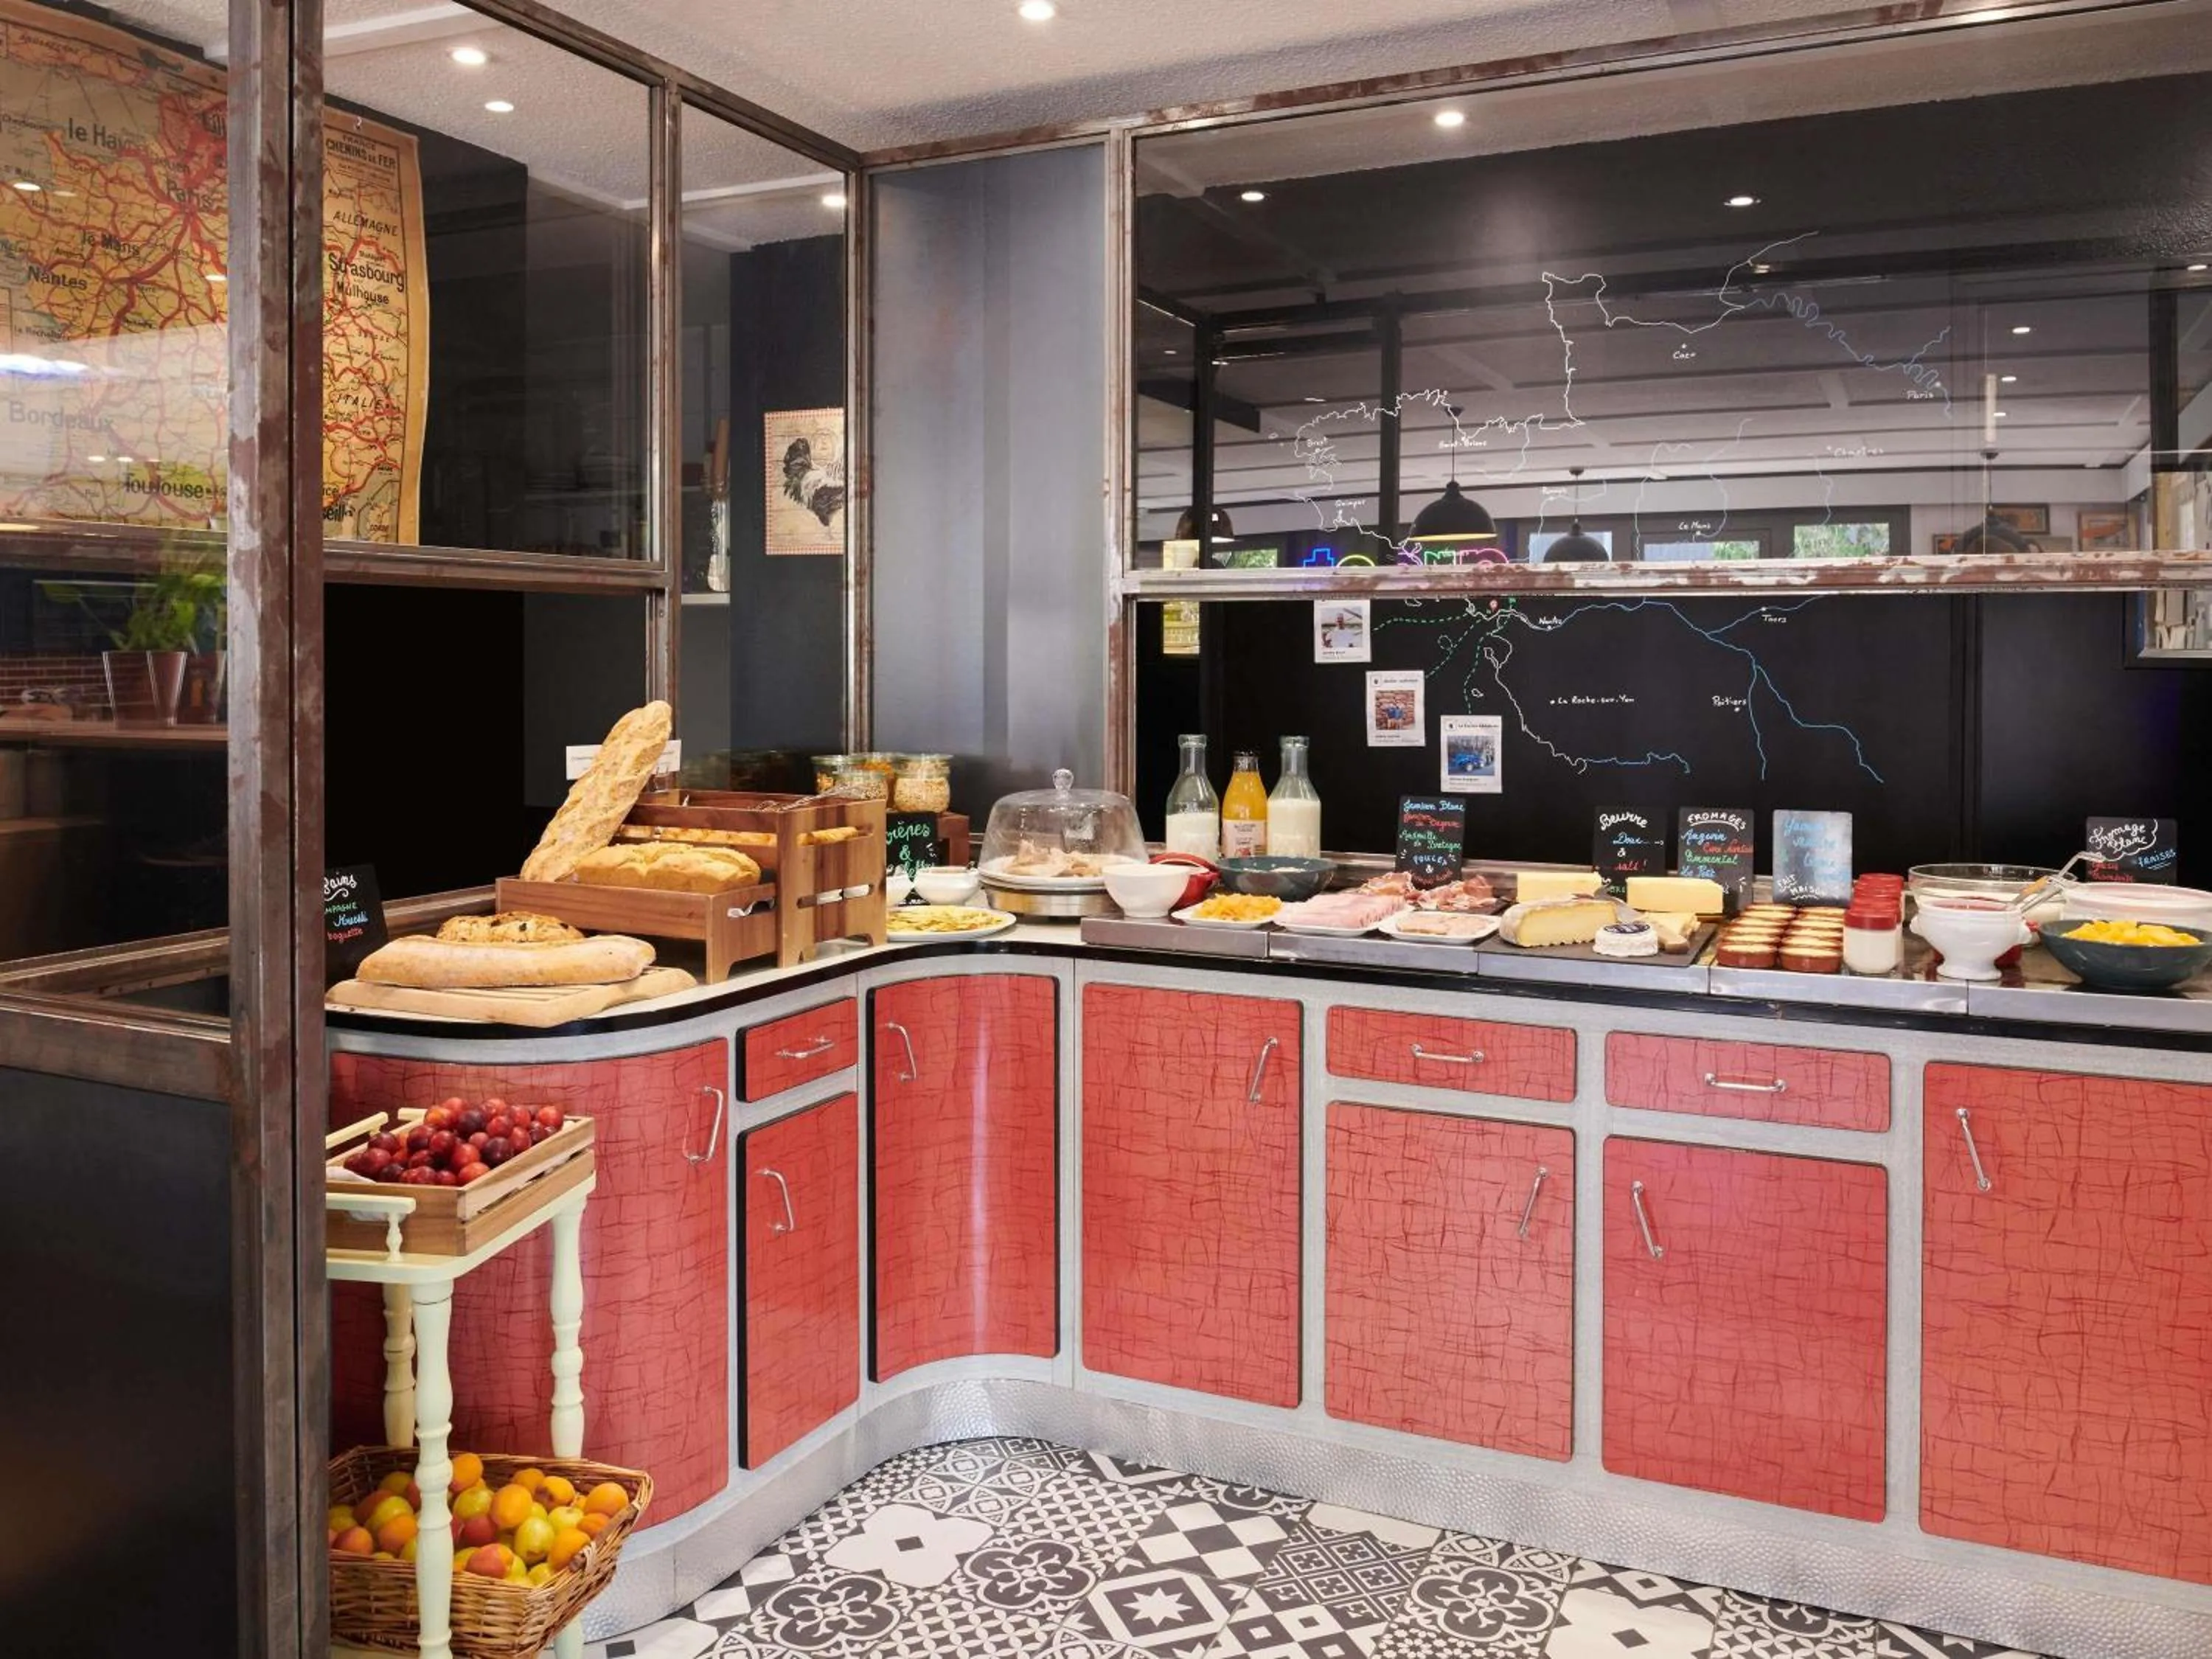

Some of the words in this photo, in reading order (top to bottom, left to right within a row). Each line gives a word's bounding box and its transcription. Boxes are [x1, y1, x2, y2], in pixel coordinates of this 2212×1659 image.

[326, 138, 367, 161] CHEMINS
[378, 154, 397, 170] FER
[166, 179, 214, 209] Paris
[333, 210, 399, 237] ALLEMAGNE
[27, 265, 88, 291] Nantes
[328, 251, 405, 293] Strasbourg
[336, 280, 390, 305] Mulhouse
[1907, 390, 1935, 400] Paris
[8, 400, 114, 433] Bordeaux
[123, 472, 204, 500] Toulouse
[1711, 695, 1747, 707] Poitiers
[886, 820, 931, 845] rêpes
[1599, 812, 1648, 831] Beurre
[1687, 812, 1747, 830] FROMAGES
[2089, 824, 2146, 849] Fromage
[900, 844, 914, 861] &
[1425, 864, 1434, 874] &
